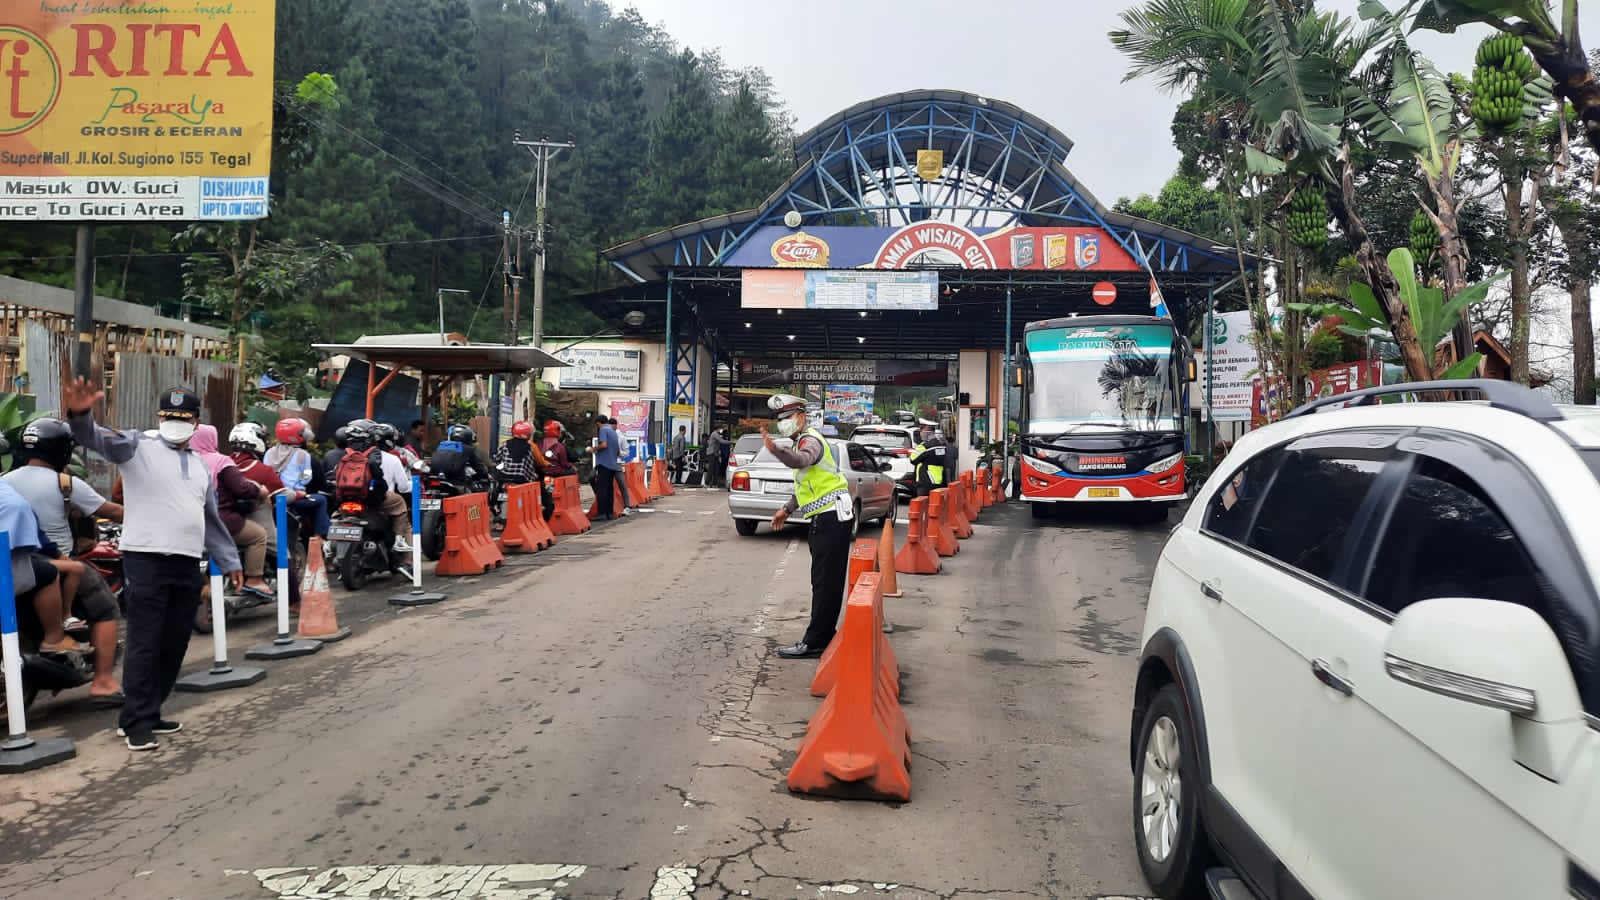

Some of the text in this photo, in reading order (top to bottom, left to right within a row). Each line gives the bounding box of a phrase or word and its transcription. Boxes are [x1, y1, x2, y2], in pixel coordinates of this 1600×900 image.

[69, 22, 254, 77] RITA
[81, 126, 242, 136] GROSIR & ECERAN
[180, 151, 204, 164] 155
[209, 151, 251, 168] Tegal
[5, 181, 73, 195] Masuk
[134, 180, 179, 195] Guci
[203, 180, 265, 197] DISHUPAR
[47, 201, 71, 216] To
[79, 201, 126, 216] Guci
[134, 201, 184, 216] Area
[203, 202, 227, 216] UPTD
[243, 201, 264, 216] GUCI
[881, 234, 914, 269] AMAN
[914, 227, 966, 250] WISATA
[964, 245, 990, 269] GUC
[1058, 340, 1138, 353] PARIWISATA
[837, 373, 872, 381] WISATA
[1078, 456, 1126, 465] BHINNEKA
